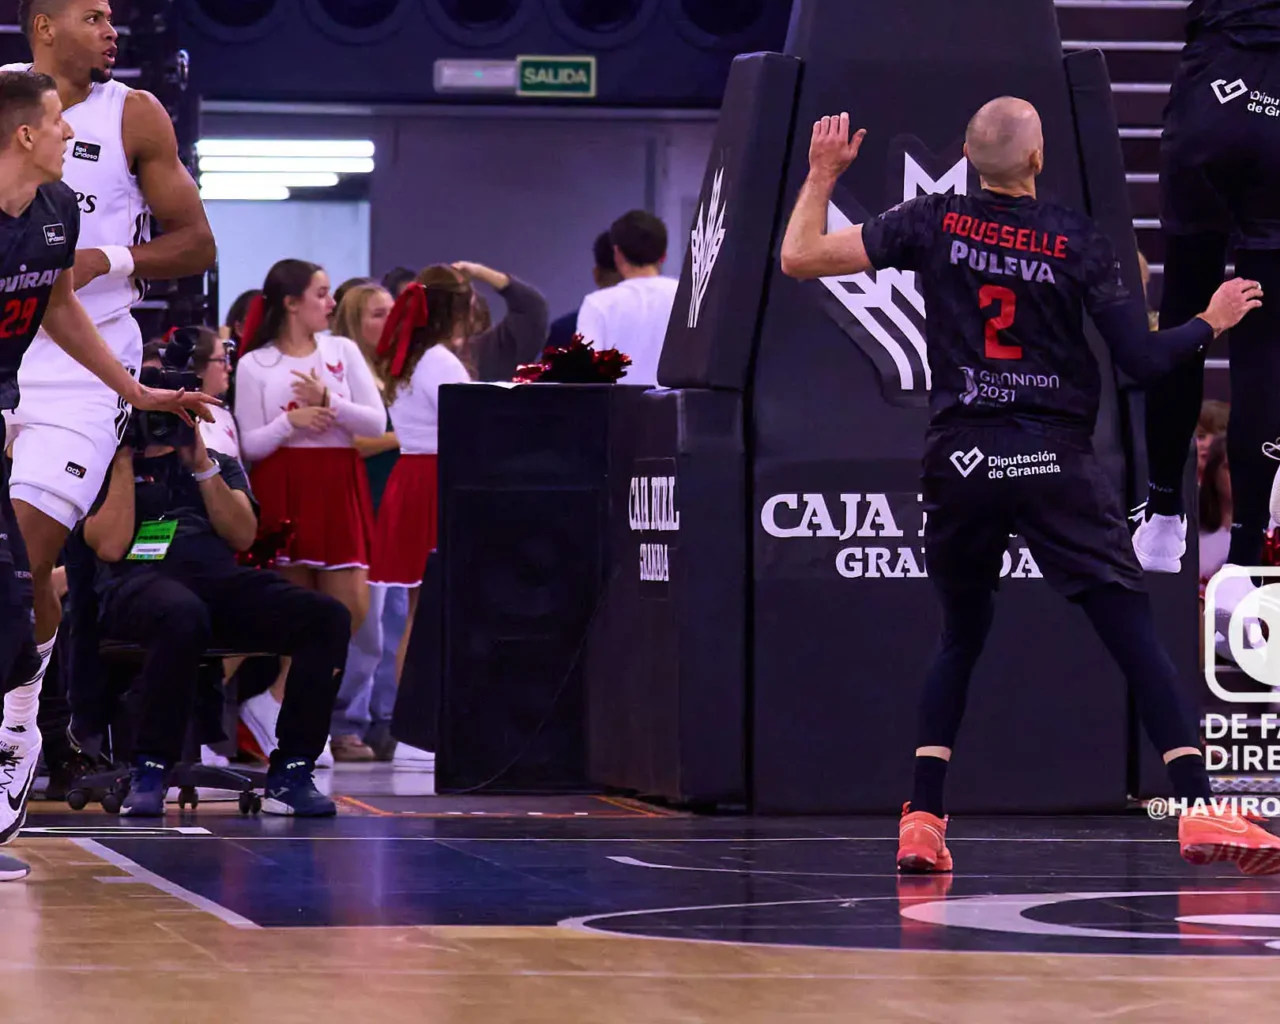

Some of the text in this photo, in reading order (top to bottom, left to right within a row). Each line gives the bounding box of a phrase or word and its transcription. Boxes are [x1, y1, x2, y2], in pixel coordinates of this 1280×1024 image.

[523, 67, 587, 85] SALIDA
[1247, 102, 1263, 114] de
[950, 240, 1056, 284] PULEVA
[978, 284, 1023, 360] 2
[979, 370, 1060, 389] GRANADA
[979, 383, 1016, 403] 2031
[988, 450, 1056, 468] Diputación
[67, 464, 82, 476] acb
[988, 463, 1061, 479] de Granada
[760, 493, 904, 541] CAJA
[640, 543, 670, 582] GRANADA
